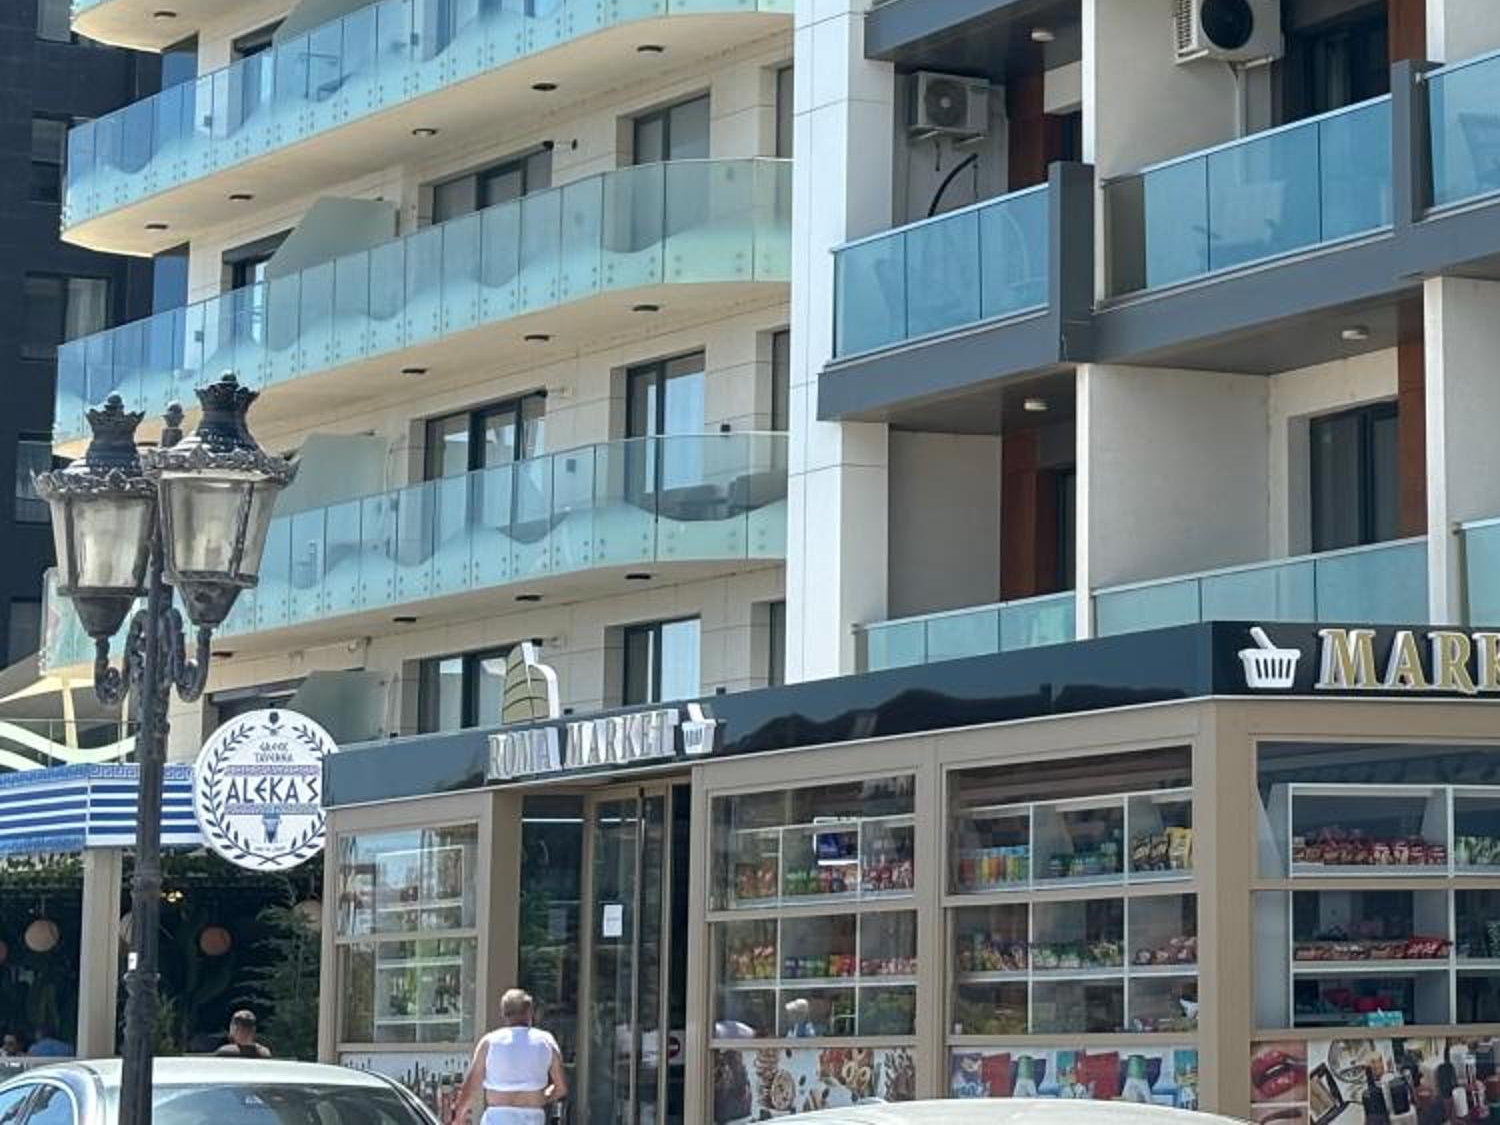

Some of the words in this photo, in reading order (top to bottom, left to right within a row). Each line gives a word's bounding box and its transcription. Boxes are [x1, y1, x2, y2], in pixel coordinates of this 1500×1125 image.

[487, 726, 562, 780] ROMA
[564, 708, 679, 769] MARKET
[225, 776, 319, 804] ALEKA'S
